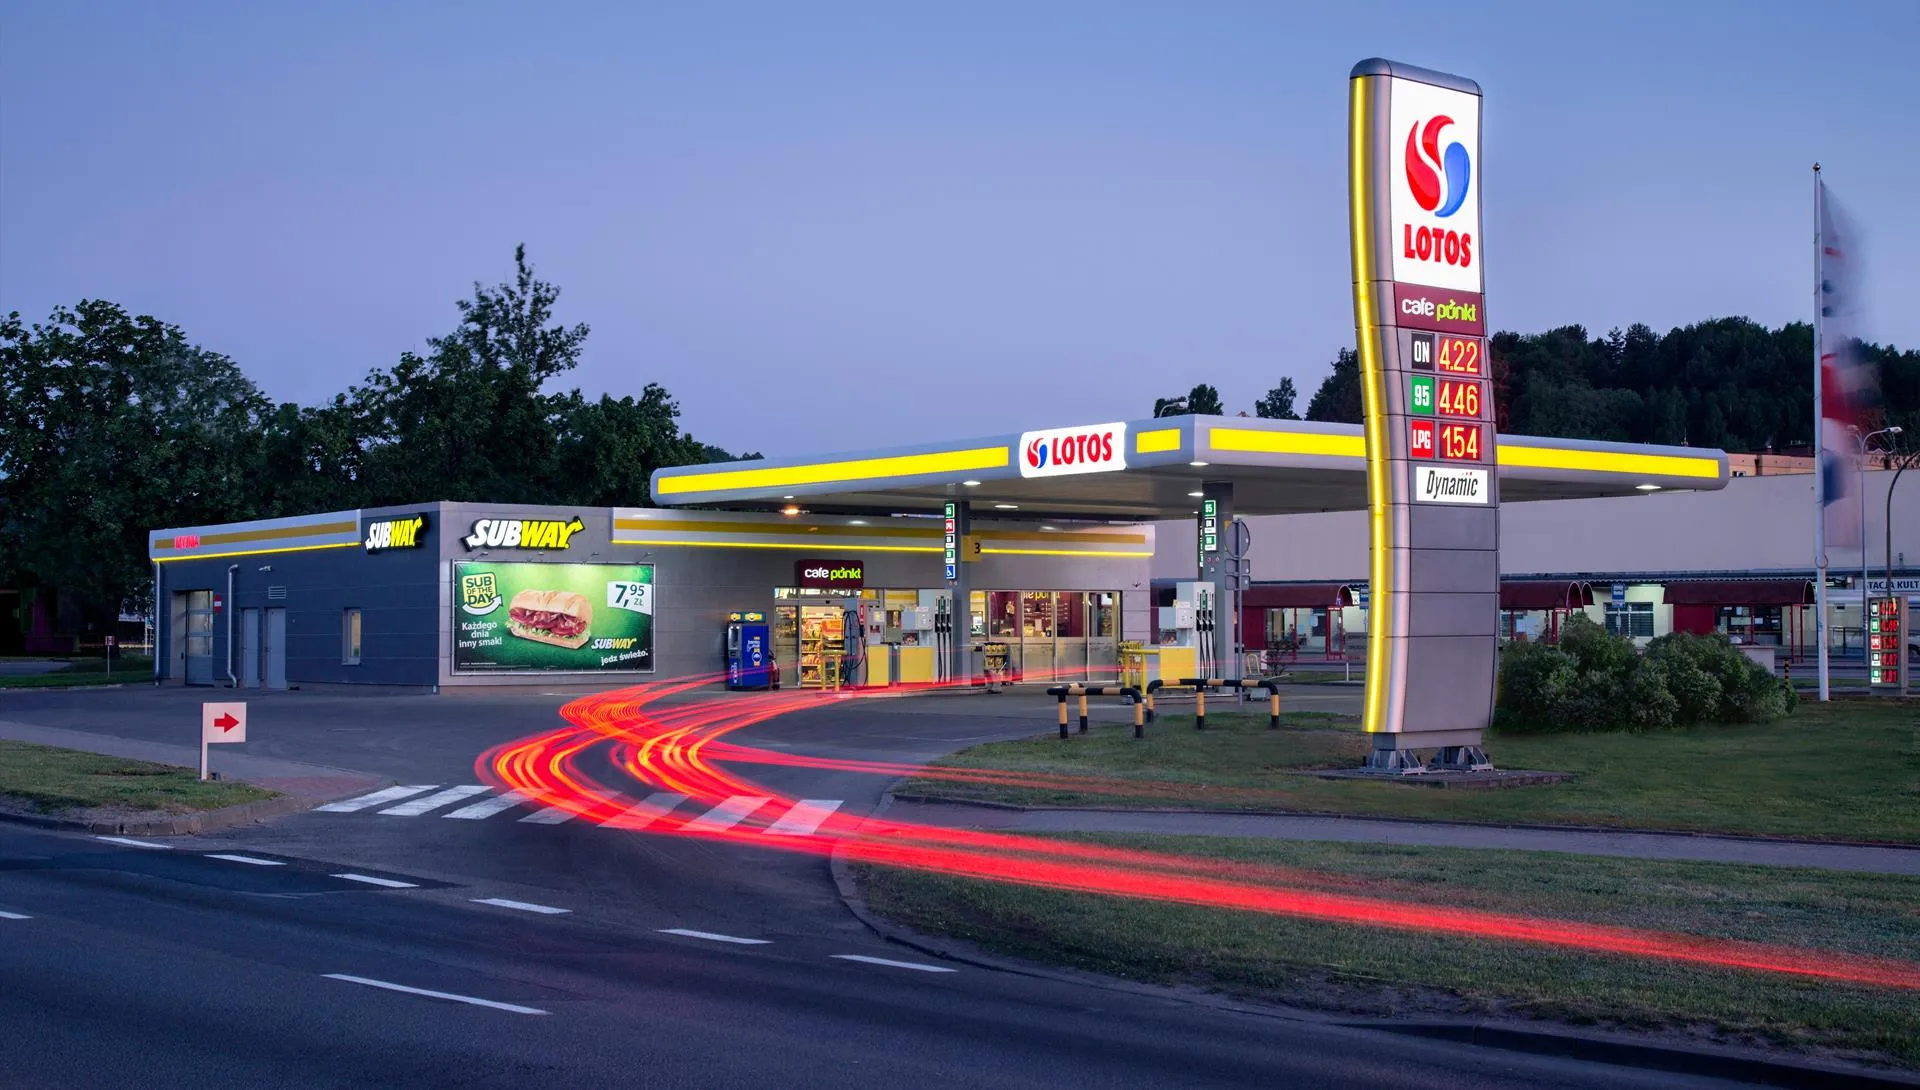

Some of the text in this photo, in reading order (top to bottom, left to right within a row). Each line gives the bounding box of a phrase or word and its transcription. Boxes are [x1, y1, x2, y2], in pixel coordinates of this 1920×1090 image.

[1404, 223, 1471, 267] LOTOS
[1401, 297, 1434, 316] cafe
[1413, 338, 1478, 373] ON 4.22
[1414, 382, 1478, 416] 95 4.46
[1052, 432, 1112, 466] LOTOS
[1412, 425, 1478, 459] LPG 1.54
[1426, 470, 1478, 499] Dynamic
[365, 516, 423, 550] SUBWAY
[466, 516, 585, 549] SUBWAY
[974, 542, 981, 554] 3
[804, 567, 830, 579] cafe
[465, 575, 493, 589] SUB
[477, 586, 493, 594] THE
[468, 592, 493, 605] DAY
[461, 621, 498, 631] Każdego
[471, 630, 489, 639] dnia
[458, 636, 503, 649] inny smak!
[591, 637, 637, 650] SUBWAY
[601, 655, 618, 666] jedz
